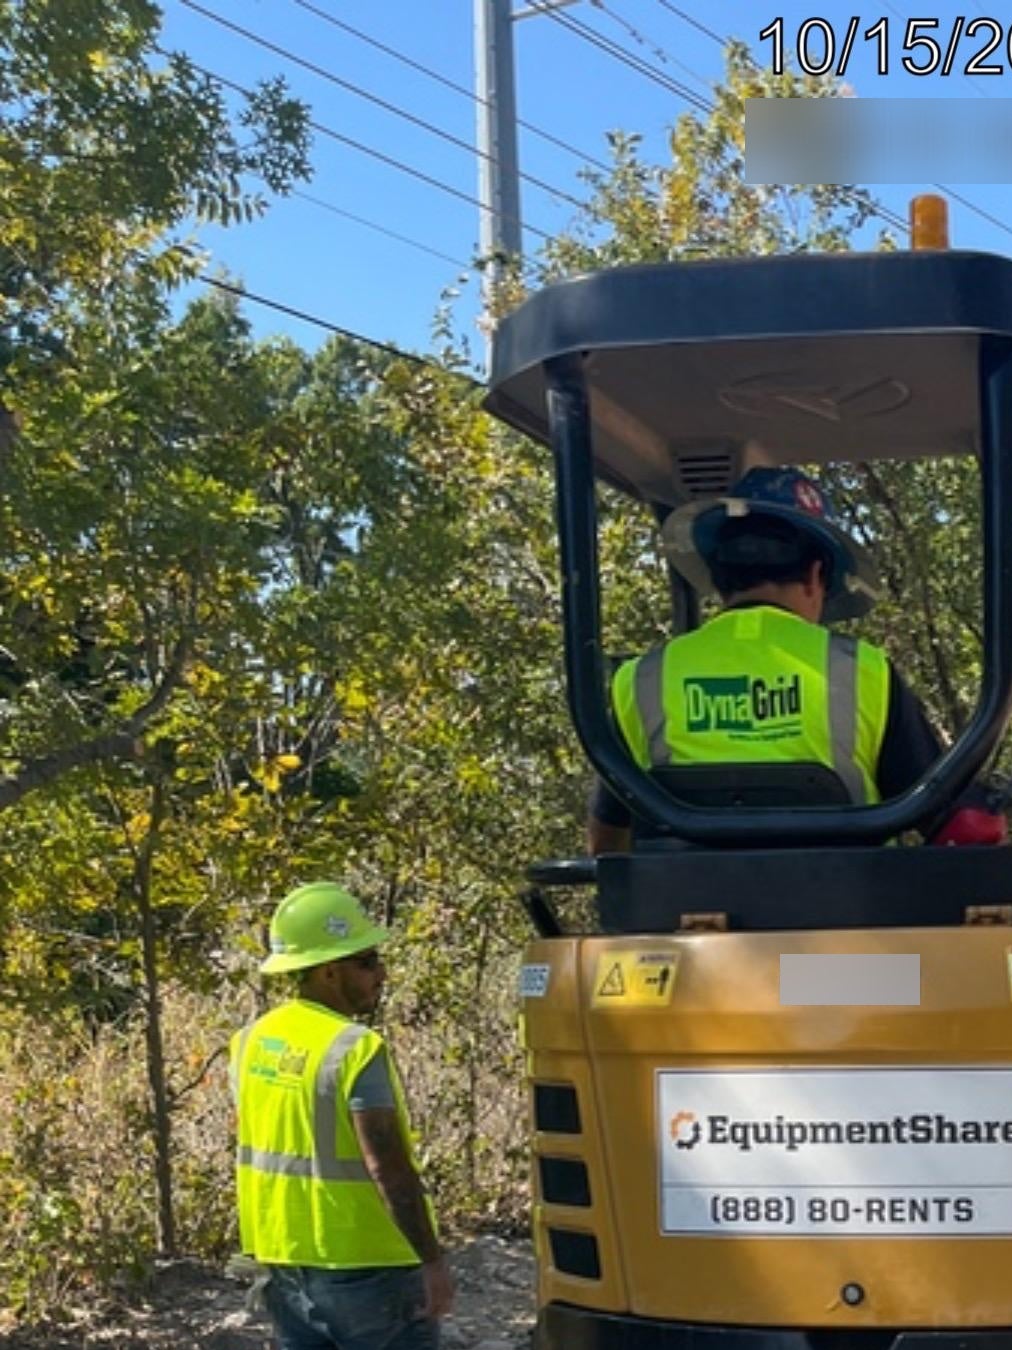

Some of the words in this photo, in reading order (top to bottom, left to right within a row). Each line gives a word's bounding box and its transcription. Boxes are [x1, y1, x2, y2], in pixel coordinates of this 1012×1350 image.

[685, 674, 801, 731] DynaGrid
[711, 1196, 795, 1223] (888)
[808, 1198, 974, 1223] 80-RENTS
